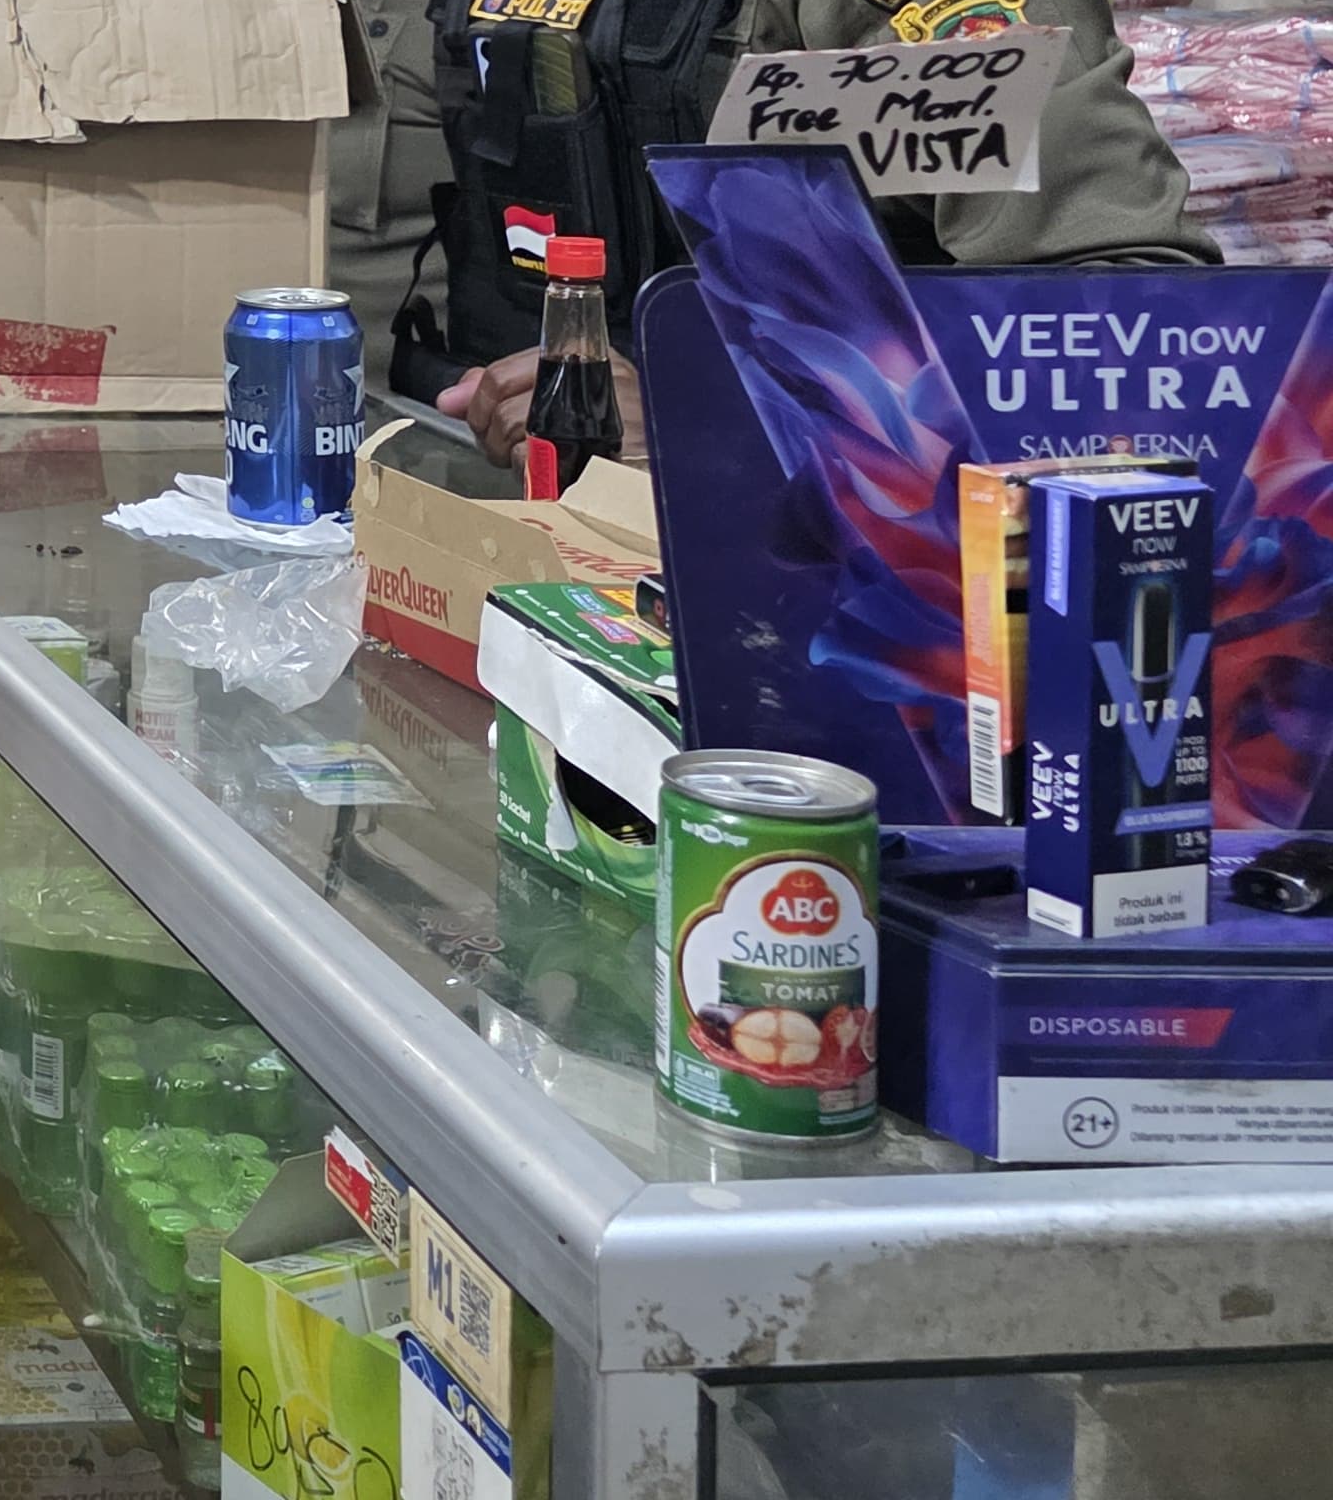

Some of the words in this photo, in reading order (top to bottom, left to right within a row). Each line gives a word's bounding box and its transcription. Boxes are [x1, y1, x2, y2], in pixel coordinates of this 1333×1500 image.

[746, 63, 804, 97] Rp.
[829, 48, 1025, 89] 70.000
[748, 97, 841, 141] Free
[858, 122, 1011, 177] VISTA
[970, 312, 1151, 358] VEEV
[1160, 325, 1266, 356] now
[985, 365, 1252, 412] ULTRA
[1109, 498, 1200, 534] VEEV
[1131, 536, 1177, 555] now
[1099, 696, 1204, 727] ULTRA
[1032, 740, 1054, 821] VEEV
[1063, 753, 1081, 833] ULTRA
[768, 896, 834, 923] ABC
[1119, 896, 1164, 909] Produk
[1166, 891, 1182, 904] ini
[733, 930, 860, 969] SARDINES
[760, 981, 840, 1002] TOMAT
[1029, 1016, 1187, 1037] DISPOSABLE
[1071, 1113, 1113, 1133] 21+
[427, 1237, 456, 1325] M1
